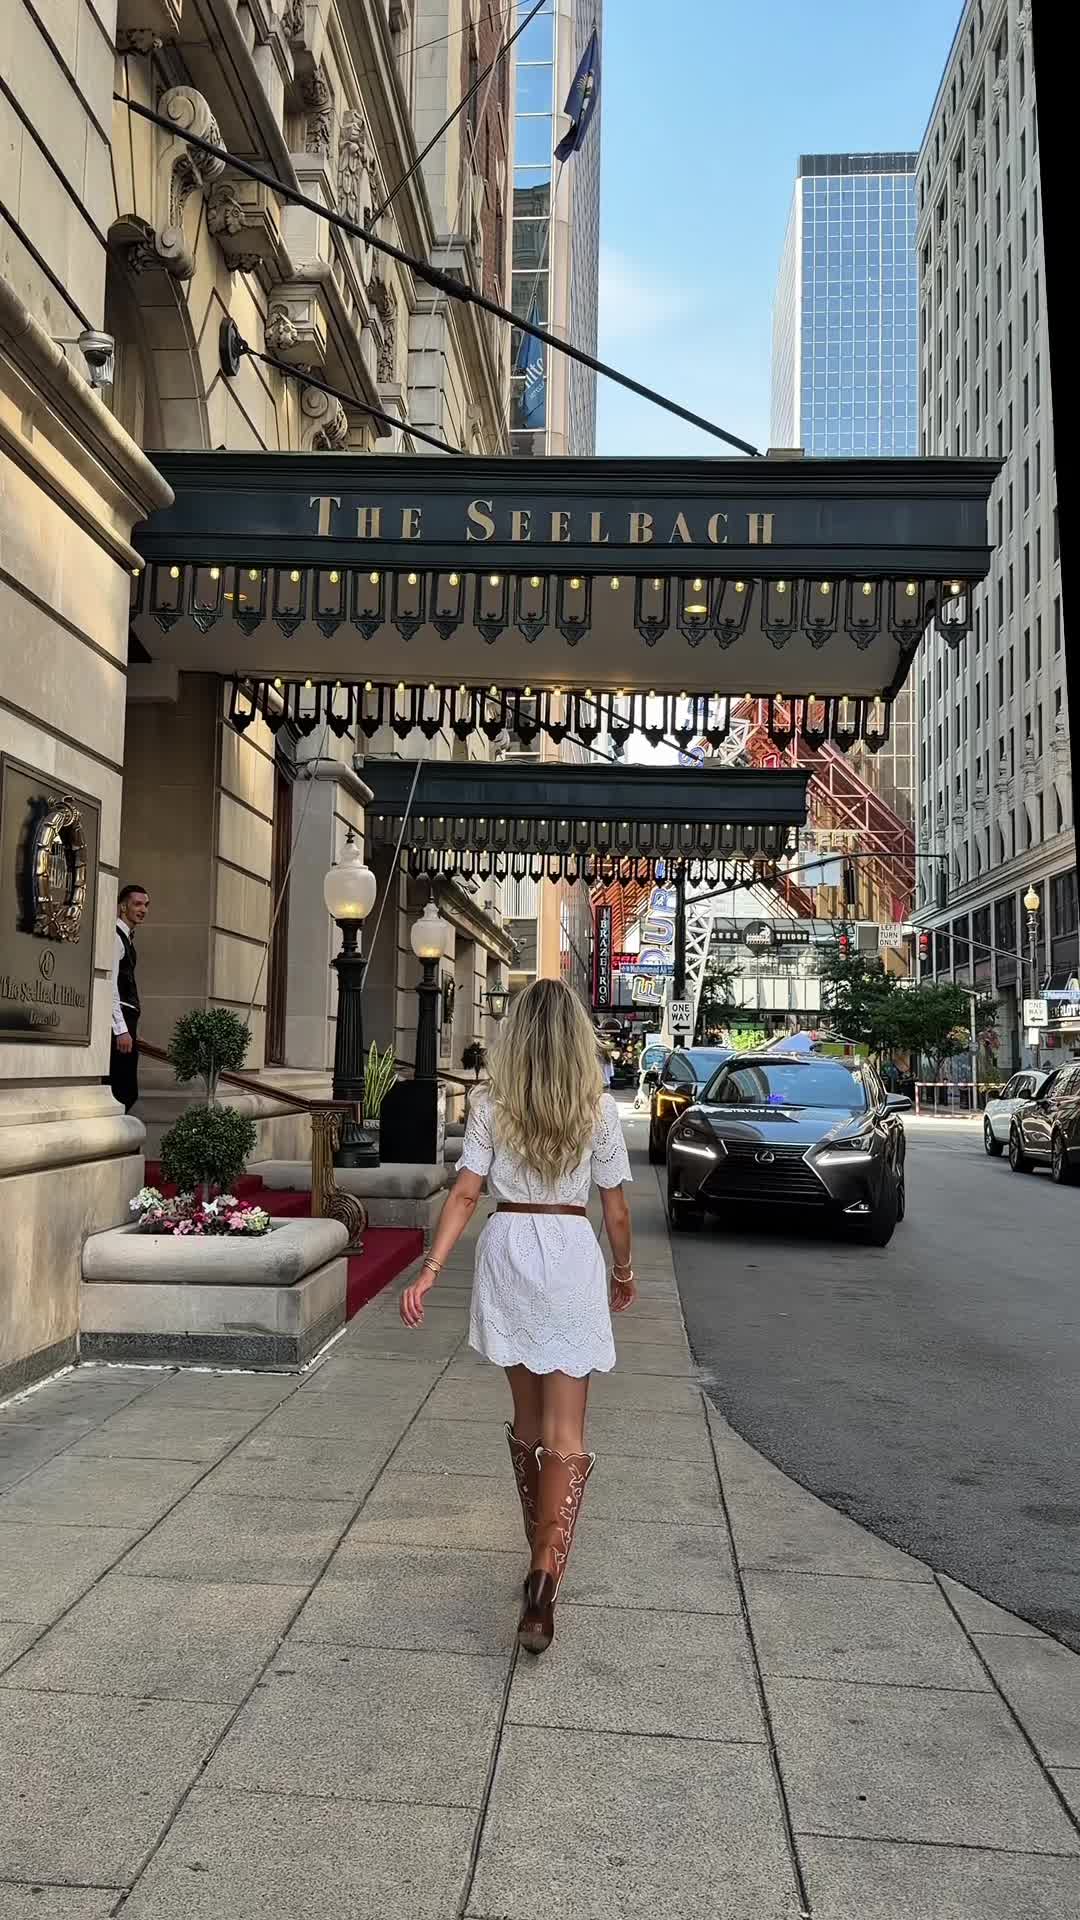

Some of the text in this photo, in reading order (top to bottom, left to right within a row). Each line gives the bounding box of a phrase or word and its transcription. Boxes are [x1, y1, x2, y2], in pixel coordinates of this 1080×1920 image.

[309, 496, 776, 545] THE SEELBACH
[598, 919, 609, 1004] BRAZEIROS
[671, 1003, 690, 1012] ONE
[671, 1012, 690, 1021] WAY
